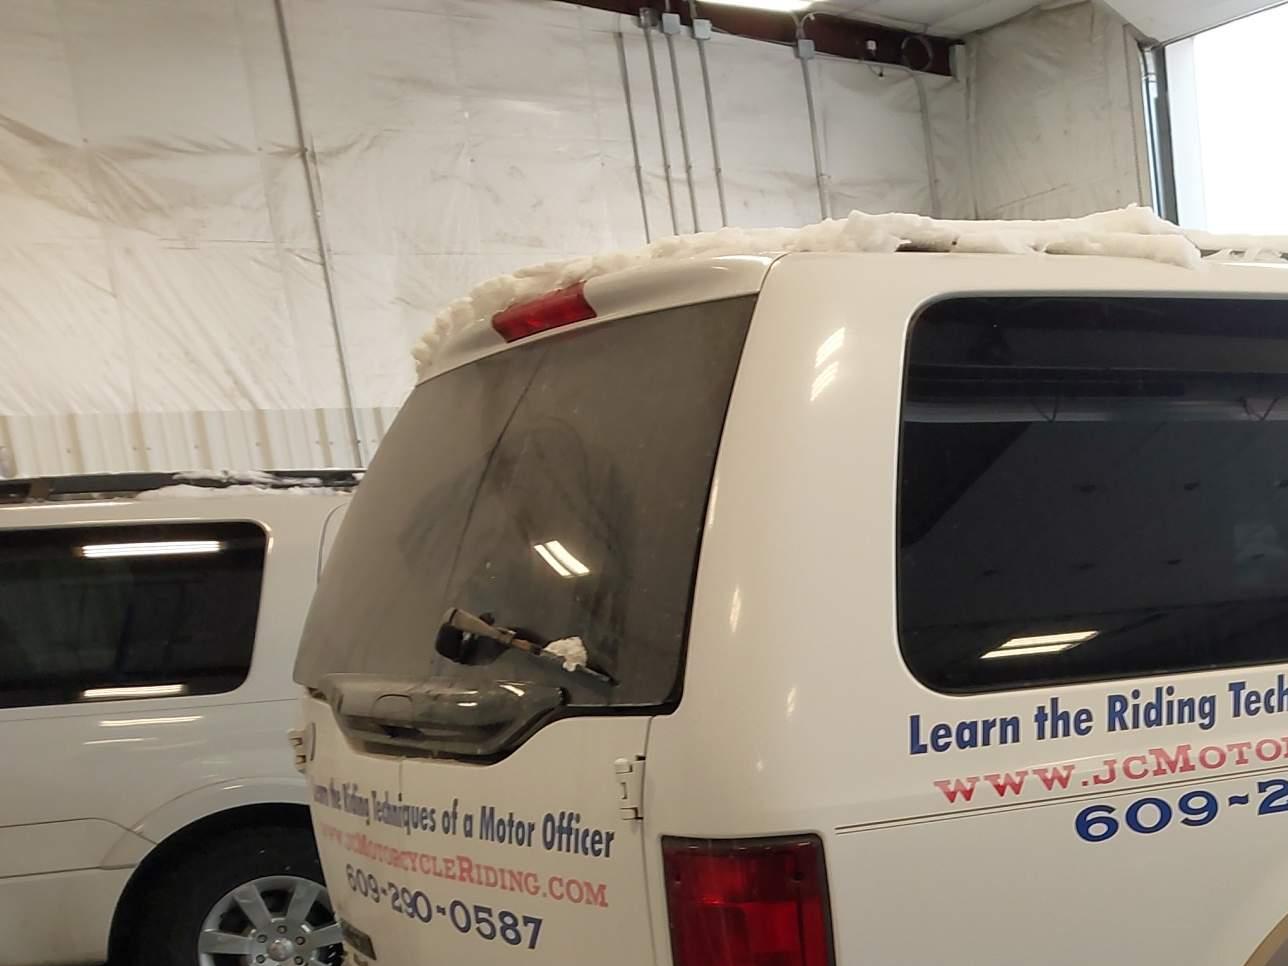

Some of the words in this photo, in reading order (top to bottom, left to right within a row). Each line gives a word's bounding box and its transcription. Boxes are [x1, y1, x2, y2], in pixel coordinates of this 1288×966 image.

[909, 714, 1021, 755] Learn
[1034, 697, 1093, 740] the
[1106, 685, 1217, 733] Riding
[441, 798, 458, 835] of
[463, 814, 473, 838] a
[479, 806, 535, 848] Motor
[542, 811, 616, 858] Officer
